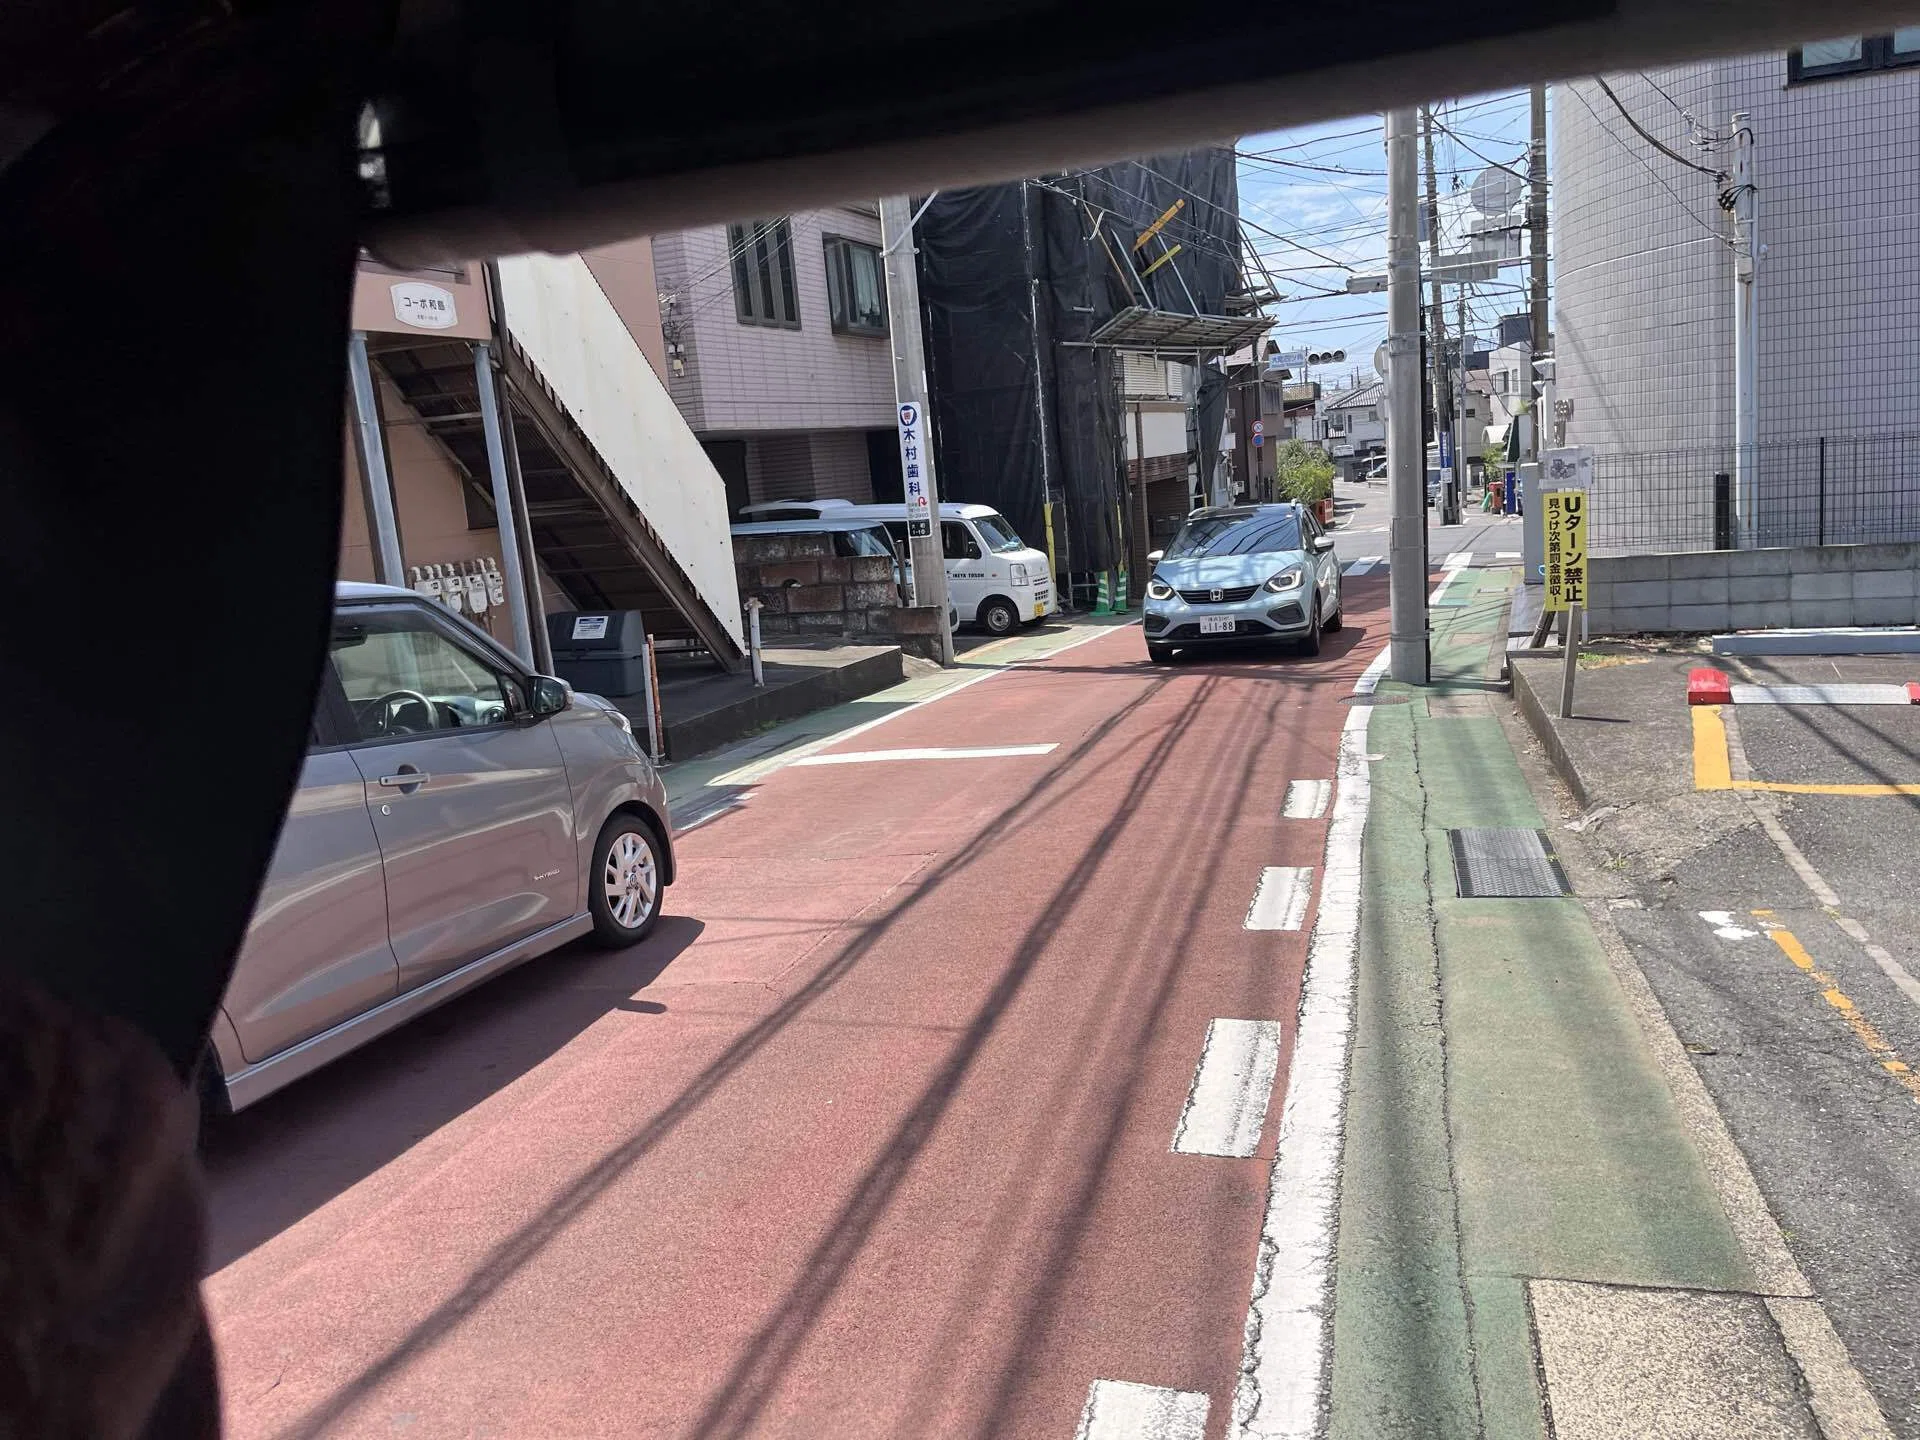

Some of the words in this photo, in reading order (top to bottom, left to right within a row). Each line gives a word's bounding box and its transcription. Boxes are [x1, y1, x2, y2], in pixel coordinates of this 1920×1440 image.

[903, 428, 920, 496] 木村歯科
[1564, 496, 1583, 602] Uターン禁止
